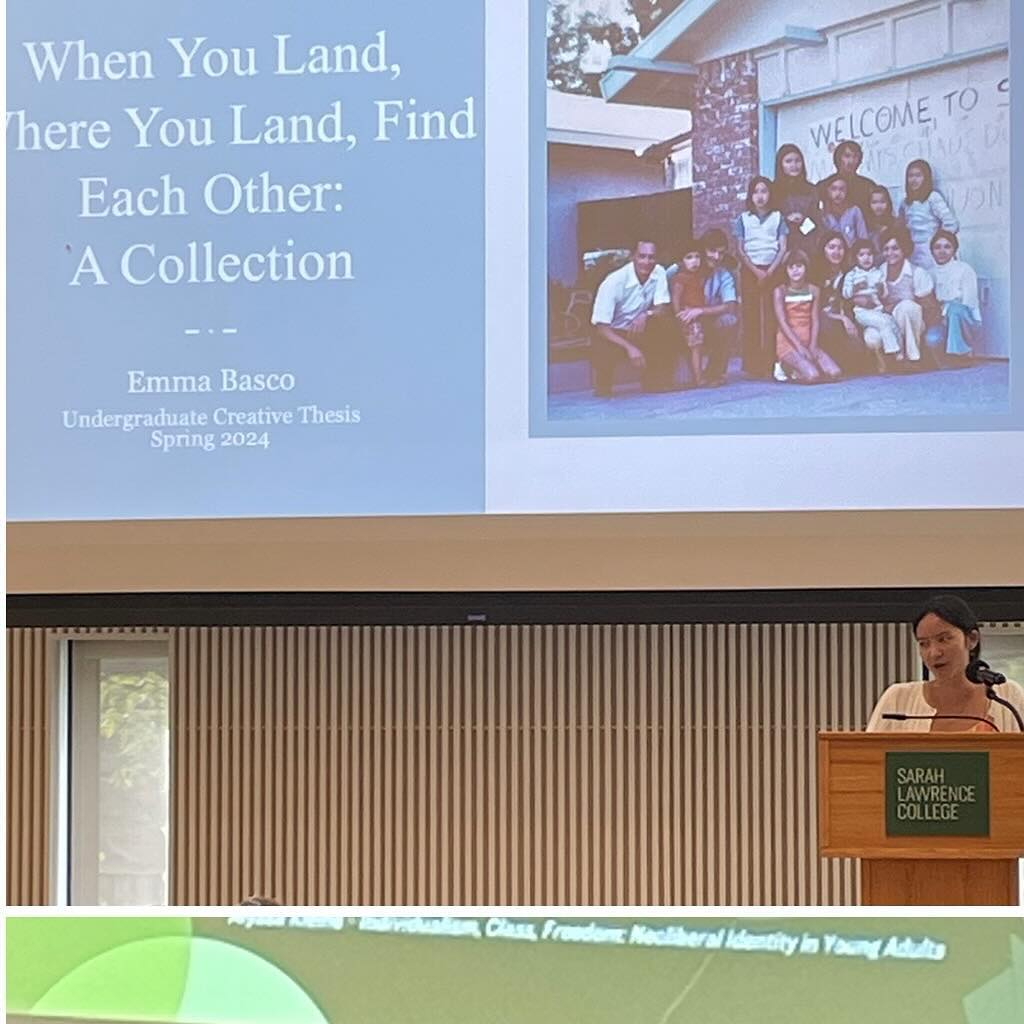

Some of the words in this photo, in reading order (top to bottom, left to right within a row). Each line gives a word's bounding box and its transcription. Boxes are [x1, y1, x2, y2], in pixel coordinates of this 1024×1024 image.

[23, 40, 154, 82] When
[168, 37, 257, 77] You
[274, 31, 400, 80] Land,
[943, 87, 979, 117] TO
[125, 108, 214, 147] You
[230, 101, 356, 149] Land,
[374, 97, 476, 140] Find
[79, 174, 186, 217] Each
[204, 172, 342, 214] Other:
[69, 246, 108, 285] A
[121, 240, 354, 284] Collection
[128, 371, 211, 392] Emma
[221, 369, 294, 391] Basco
[64, 408, 207, 431] Undergraduate
[214, 408, 292, 424] Creative
[298, 406, 360, 423] Thesis
[152, 431, 214, 451] Spring
[222, 432, 269, 448] 2024
[897, 768, 944, 784] SARAH
[898, 786, 976, 802] LAWRENCE
[897, 803, 959, 820] COLLEGE
[800, 933, 819, 953] in
[823, 934, 881, 960] Young
